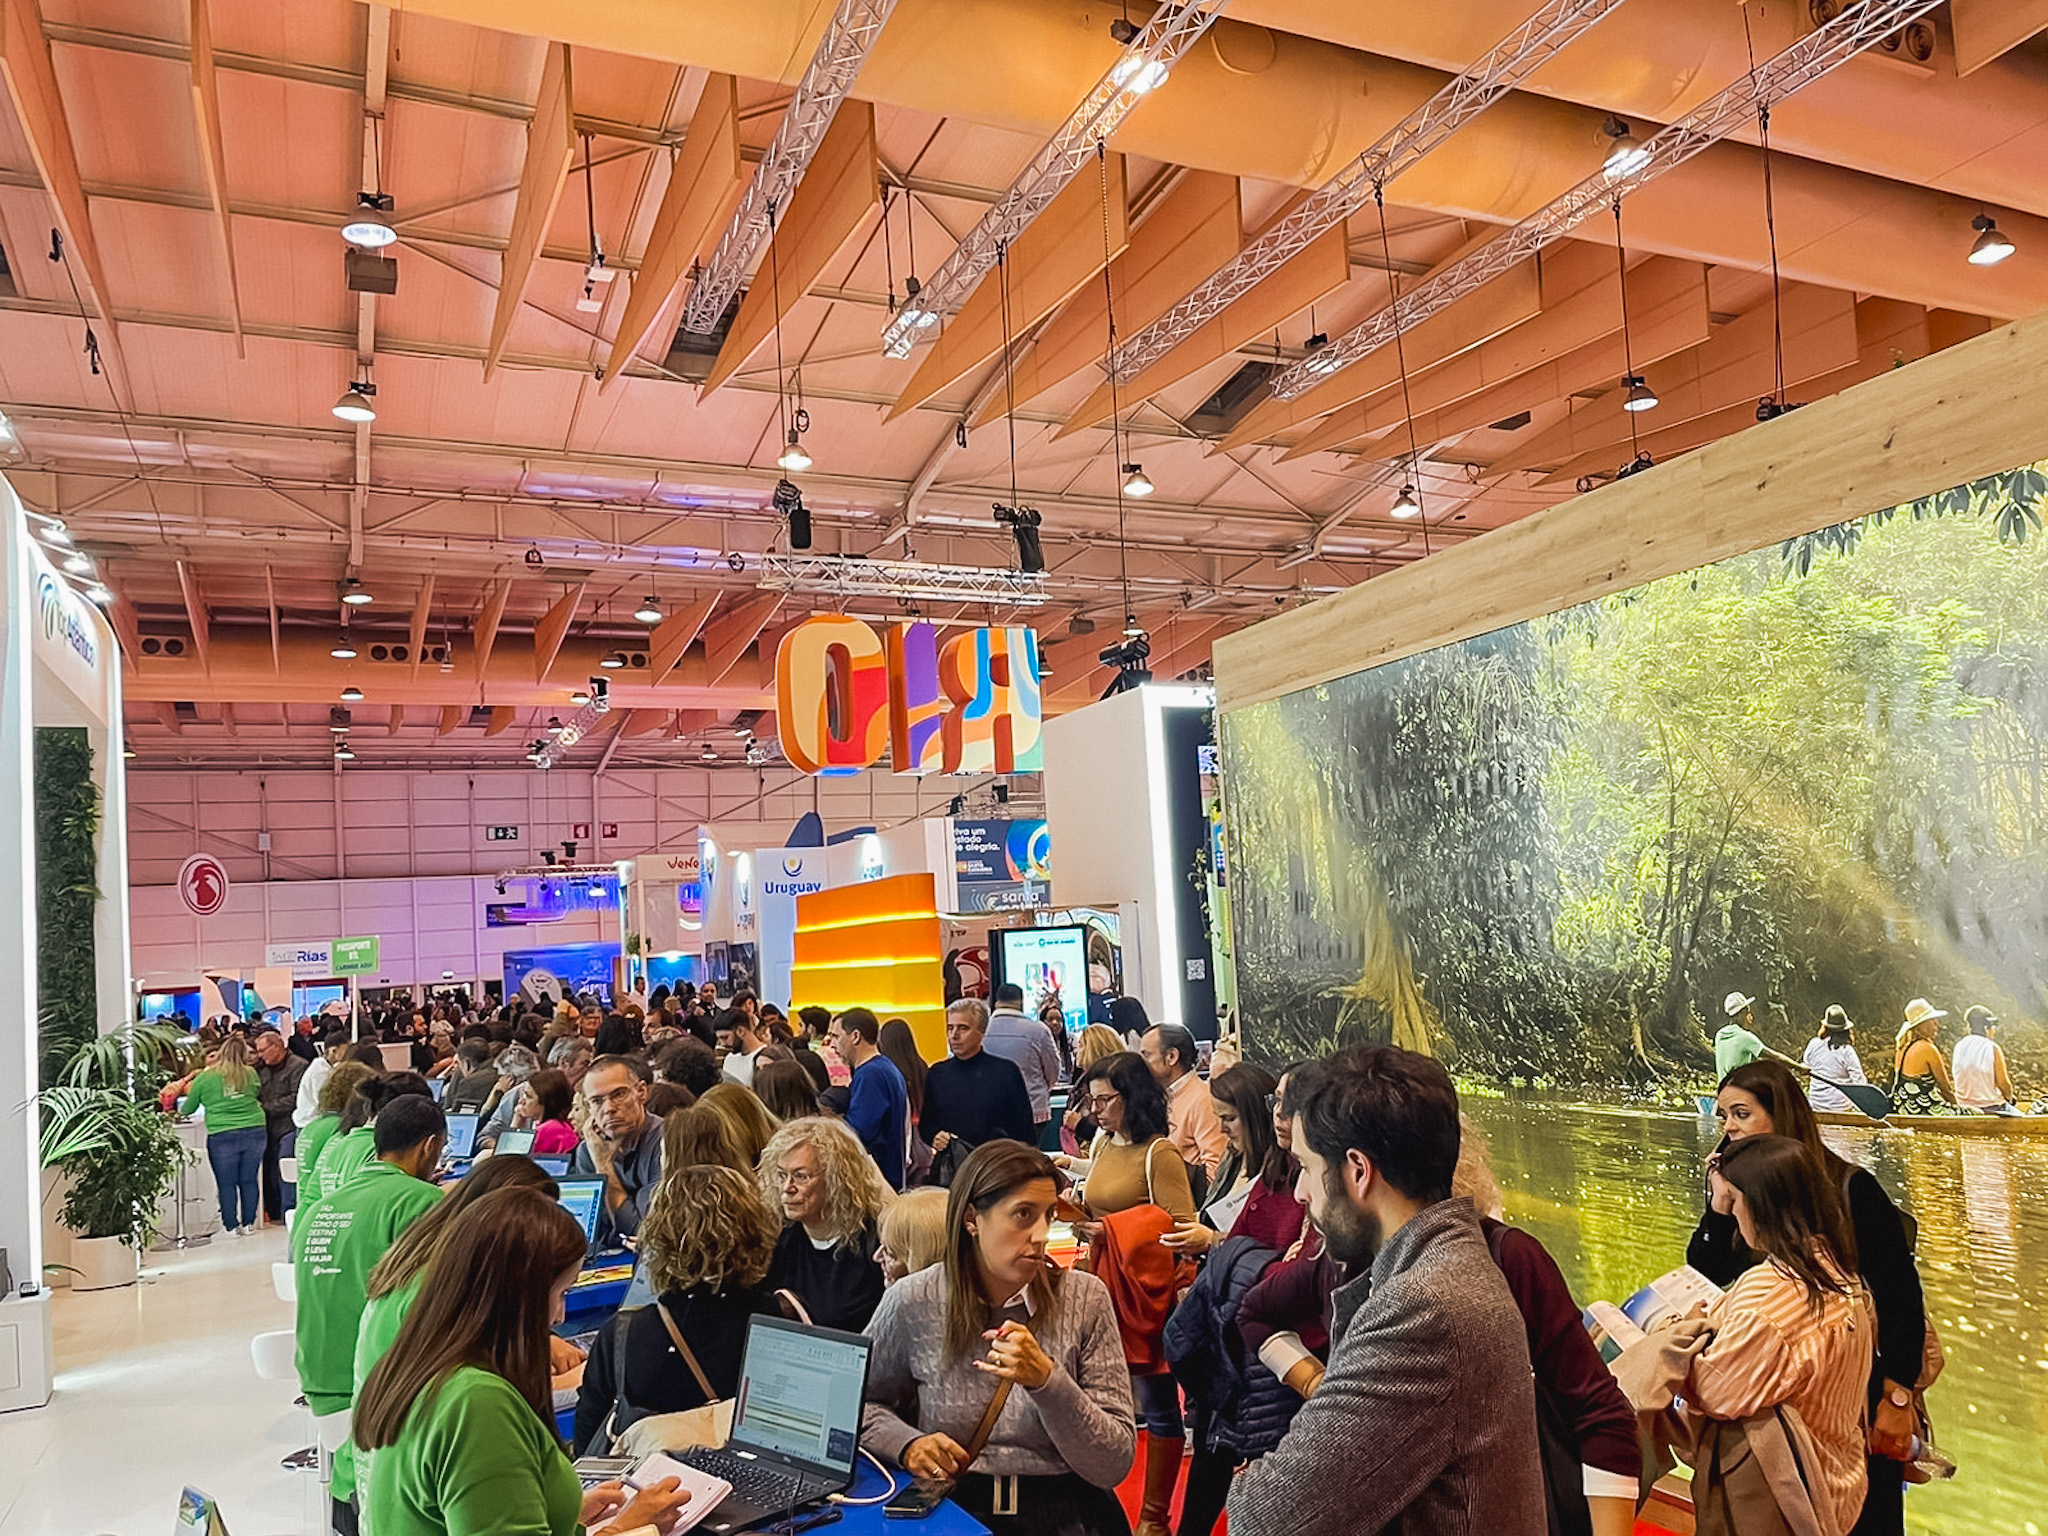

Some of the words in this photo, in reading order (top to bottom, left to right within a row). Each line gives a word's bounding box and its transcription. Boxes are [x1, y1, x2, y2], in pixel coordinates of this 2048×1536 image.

[971, 828, 986, 836] um
[965, 842, 1000, 854] alegria.
[765, 881, 821, 896] Uruguay
